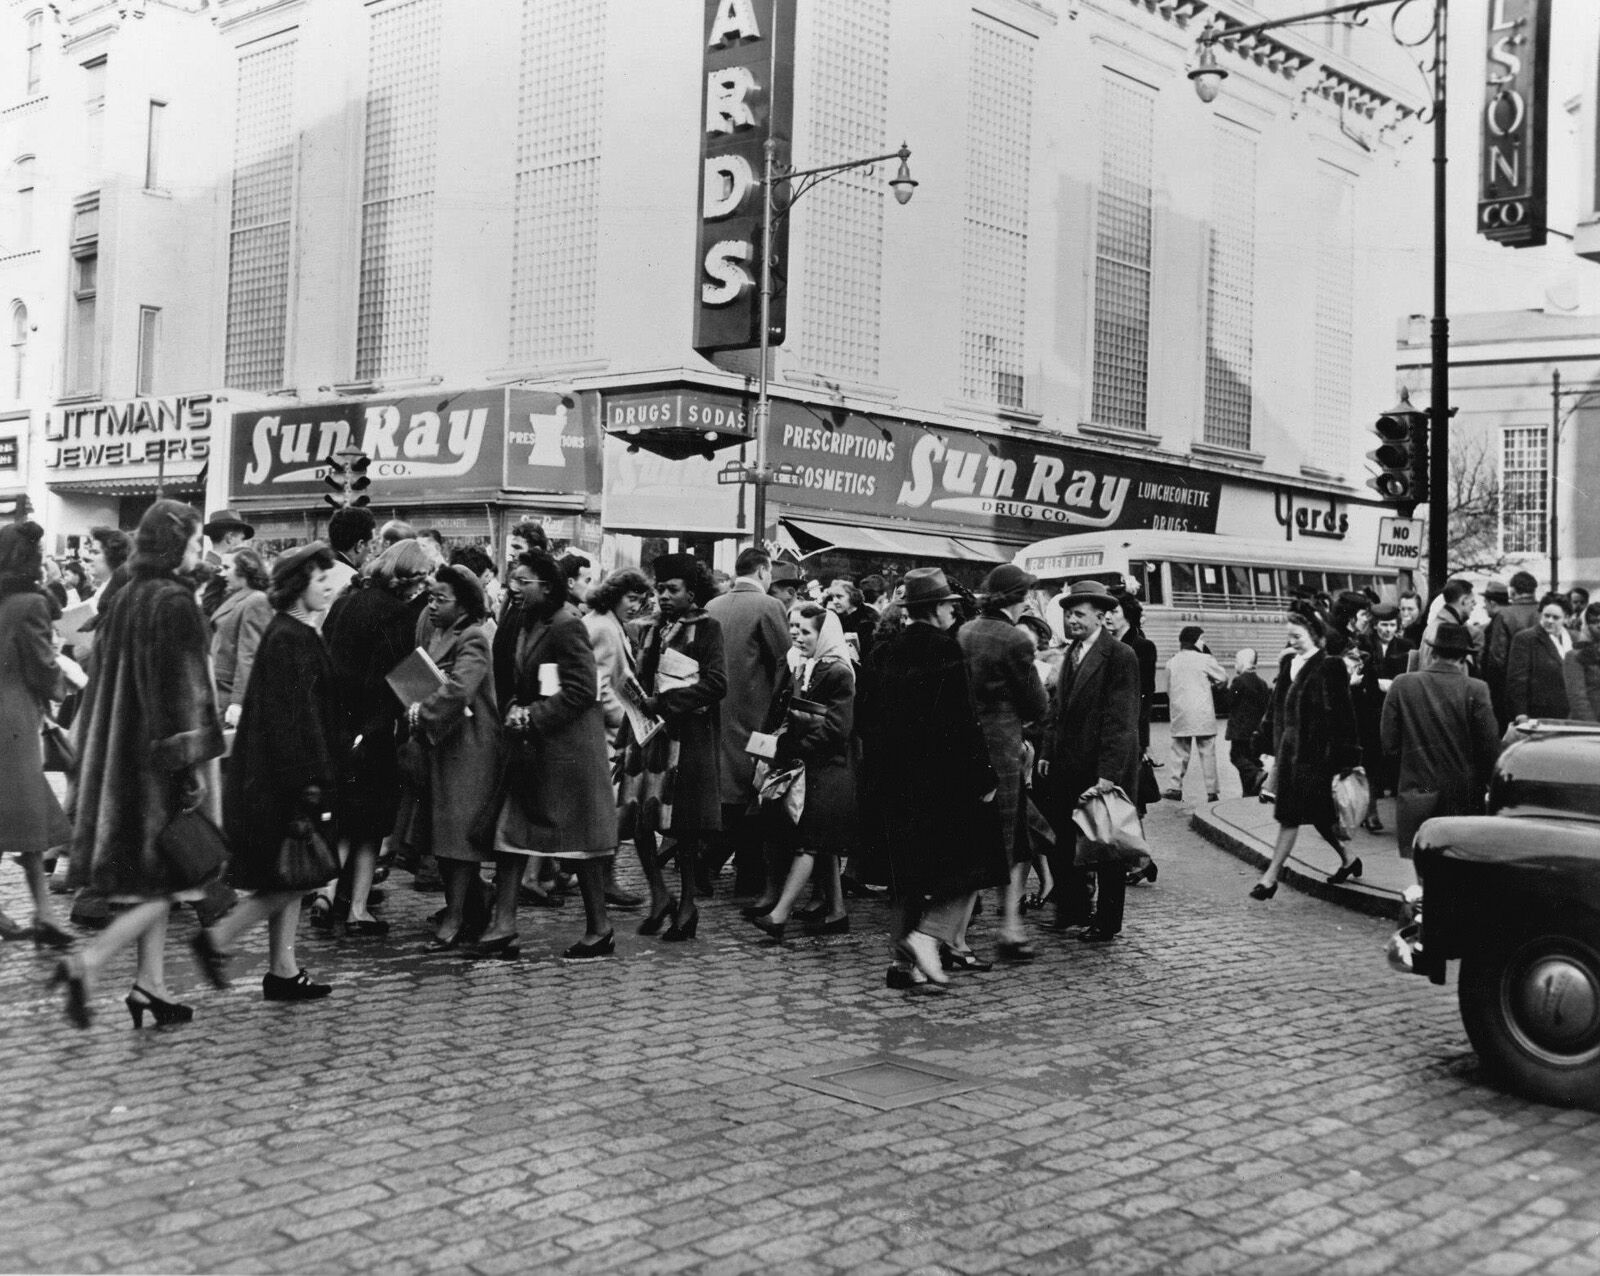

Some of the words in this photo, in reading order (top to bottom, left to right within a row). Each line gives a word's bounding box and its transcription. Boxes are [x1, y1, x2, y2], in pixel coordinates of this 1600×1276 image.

[1483, 202, 1524, 228] CO
[45, 394, 212, 442] LITTMAN'S
[615, 404, 671, 424] DRUGS
[688, 405, 746, 429] SODAS
[46, 436, 210, 468] JEWELERS
[244, 416, 351, 485] Sun
[361, 405, 488, 476] Ray
[783, 424, 895, 461] PRESCRIPTIONS
[379, 463, 411, 476] CO.
[796, 465, 876, 496] COSMETICS
[897, 433, 1017, 508] Sun
[1025, 454, 1131, 528] Ray
[1138, 481, 1210, 508] LUNCHEONETTE
[982, 501, 1033, 518] DRUG
[1041, 508, 1070, 522] CO.
[1152, 515, 1188, 532] DRUGS
[1274, 491, 1349, 541] Yards
[1392, 527, 1409, 540] NO
[1380, 543, 1418, 559] TURNS
